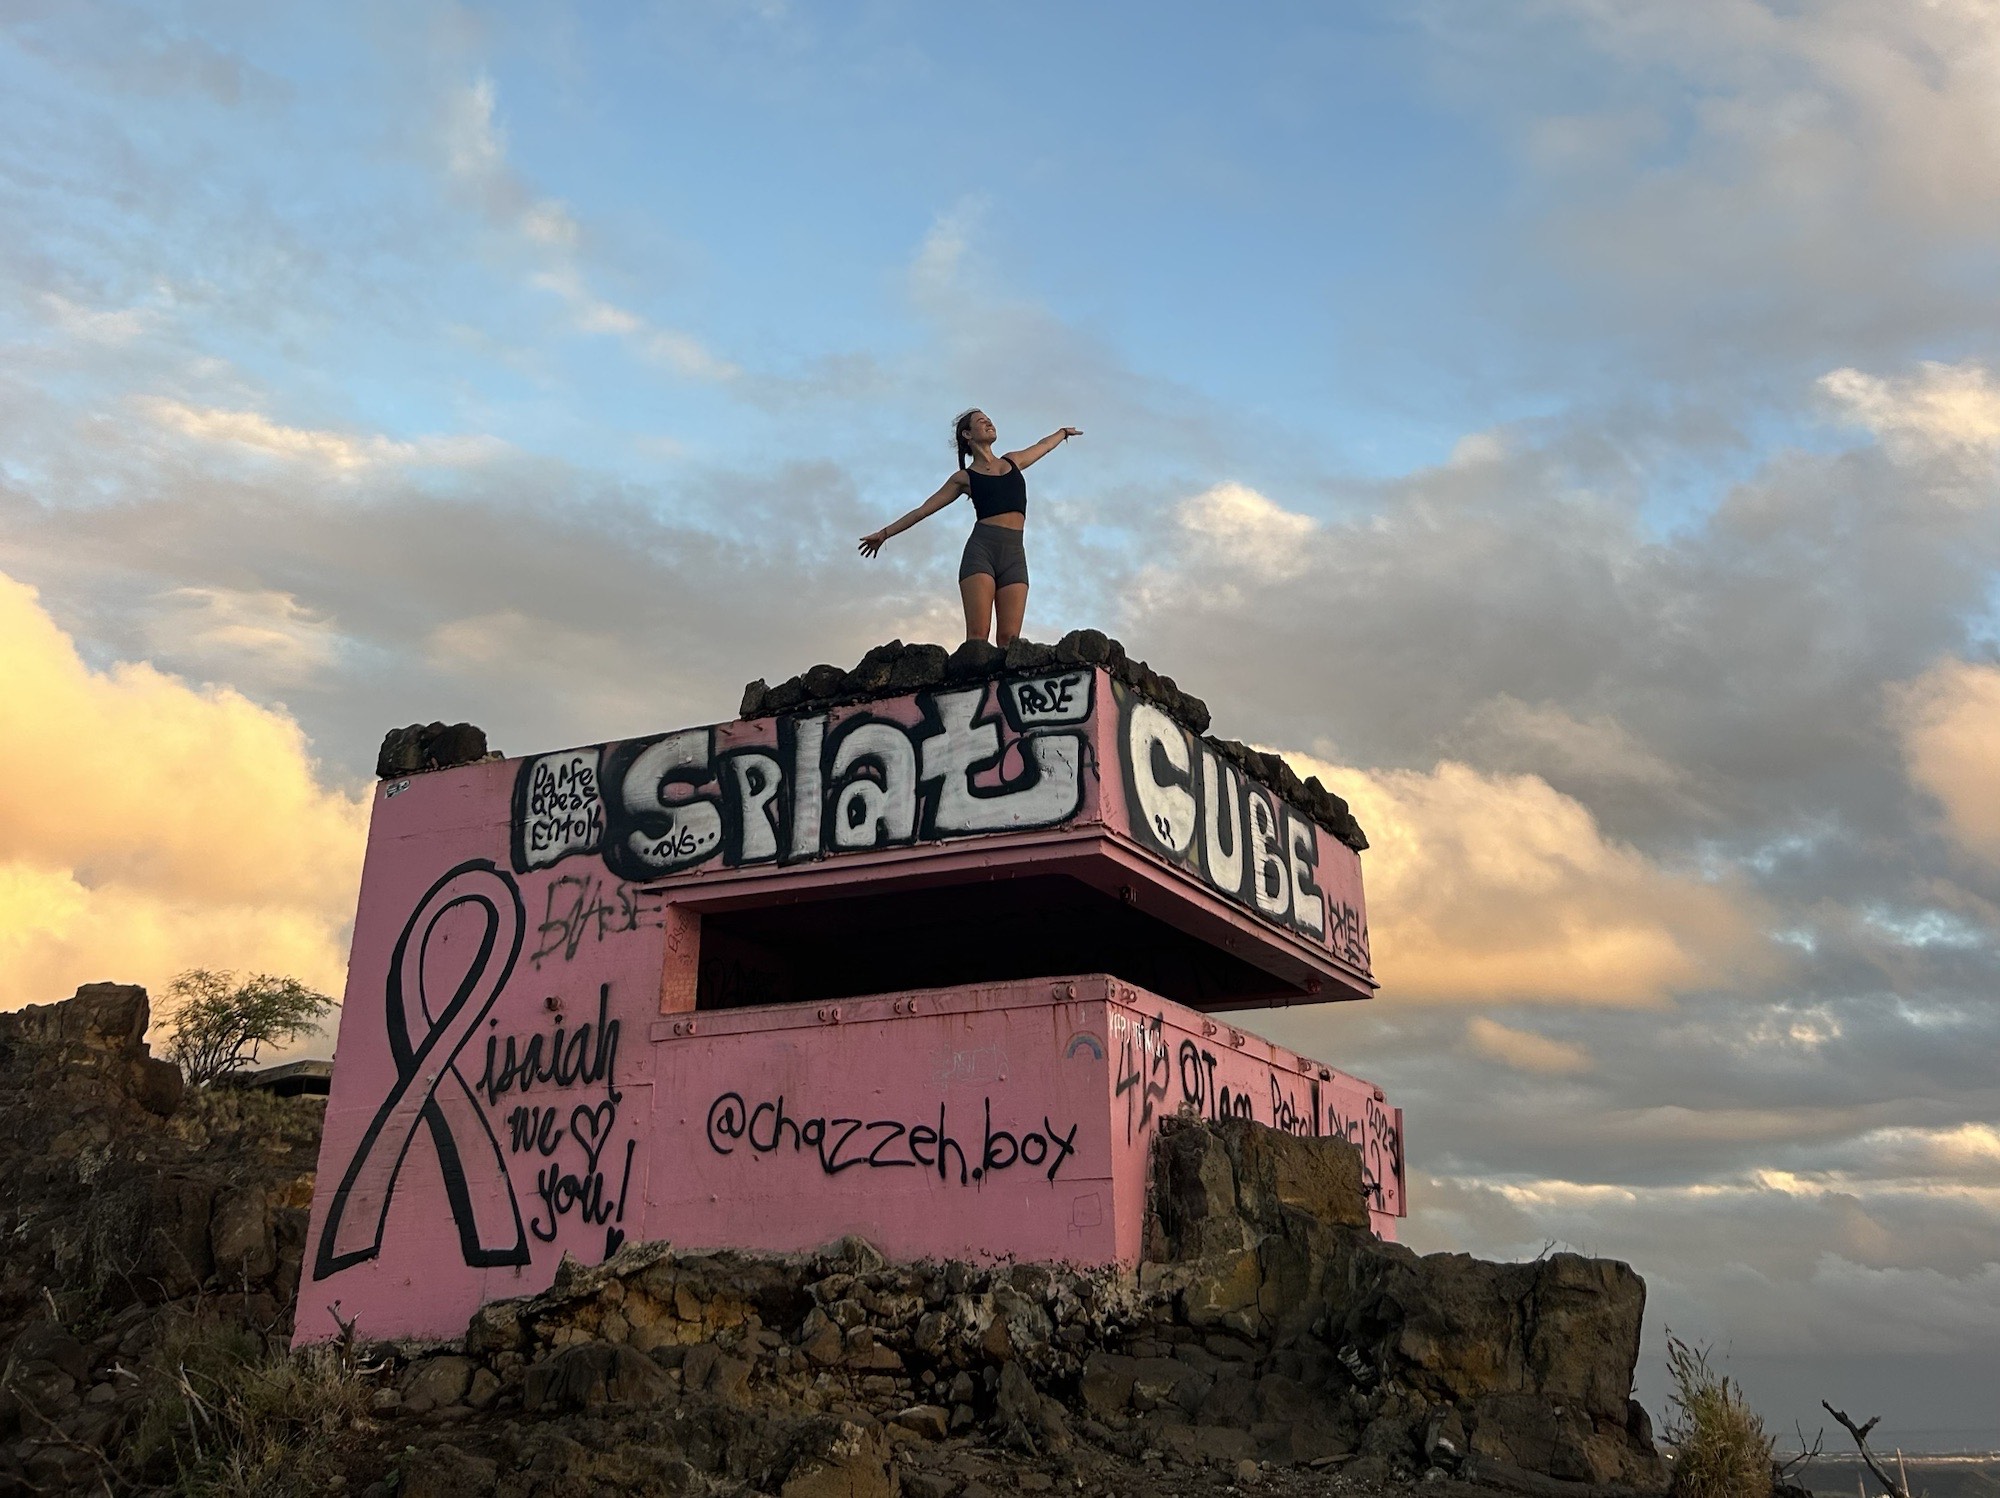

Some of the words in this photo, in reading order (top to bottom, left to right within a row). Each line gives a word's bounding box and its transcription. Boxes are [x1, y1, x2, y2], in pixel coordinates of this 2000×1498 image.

[1018, 677, 1082, 716] ROSE
[1129, 702, 1325, 933] CUBE
[508, 1105, 563, 1156] we
